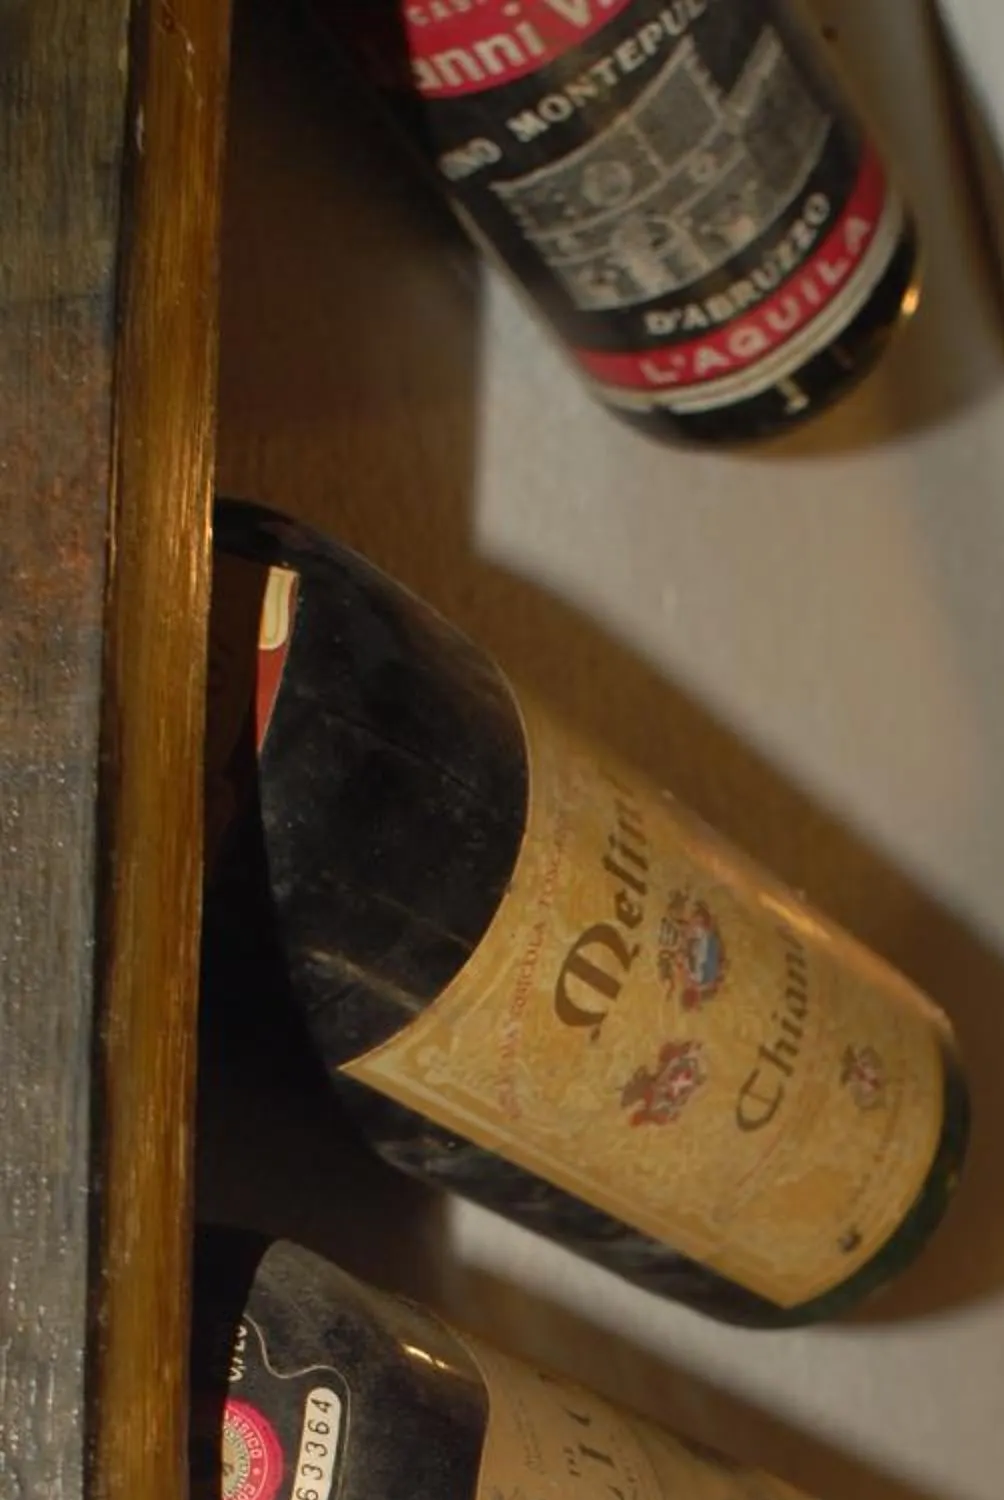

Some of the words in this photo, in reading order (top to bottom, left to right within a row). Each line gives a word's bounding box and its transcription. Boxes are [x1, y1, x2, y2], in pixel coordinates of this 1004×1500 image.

[504, 0, 708, 143] MONTEPUL
[639, 215, 871, 385] L'AQUILA
[644, 192, 831, 336] D'ABRUZZO
[736, 922, 809, 1132] Chiant
